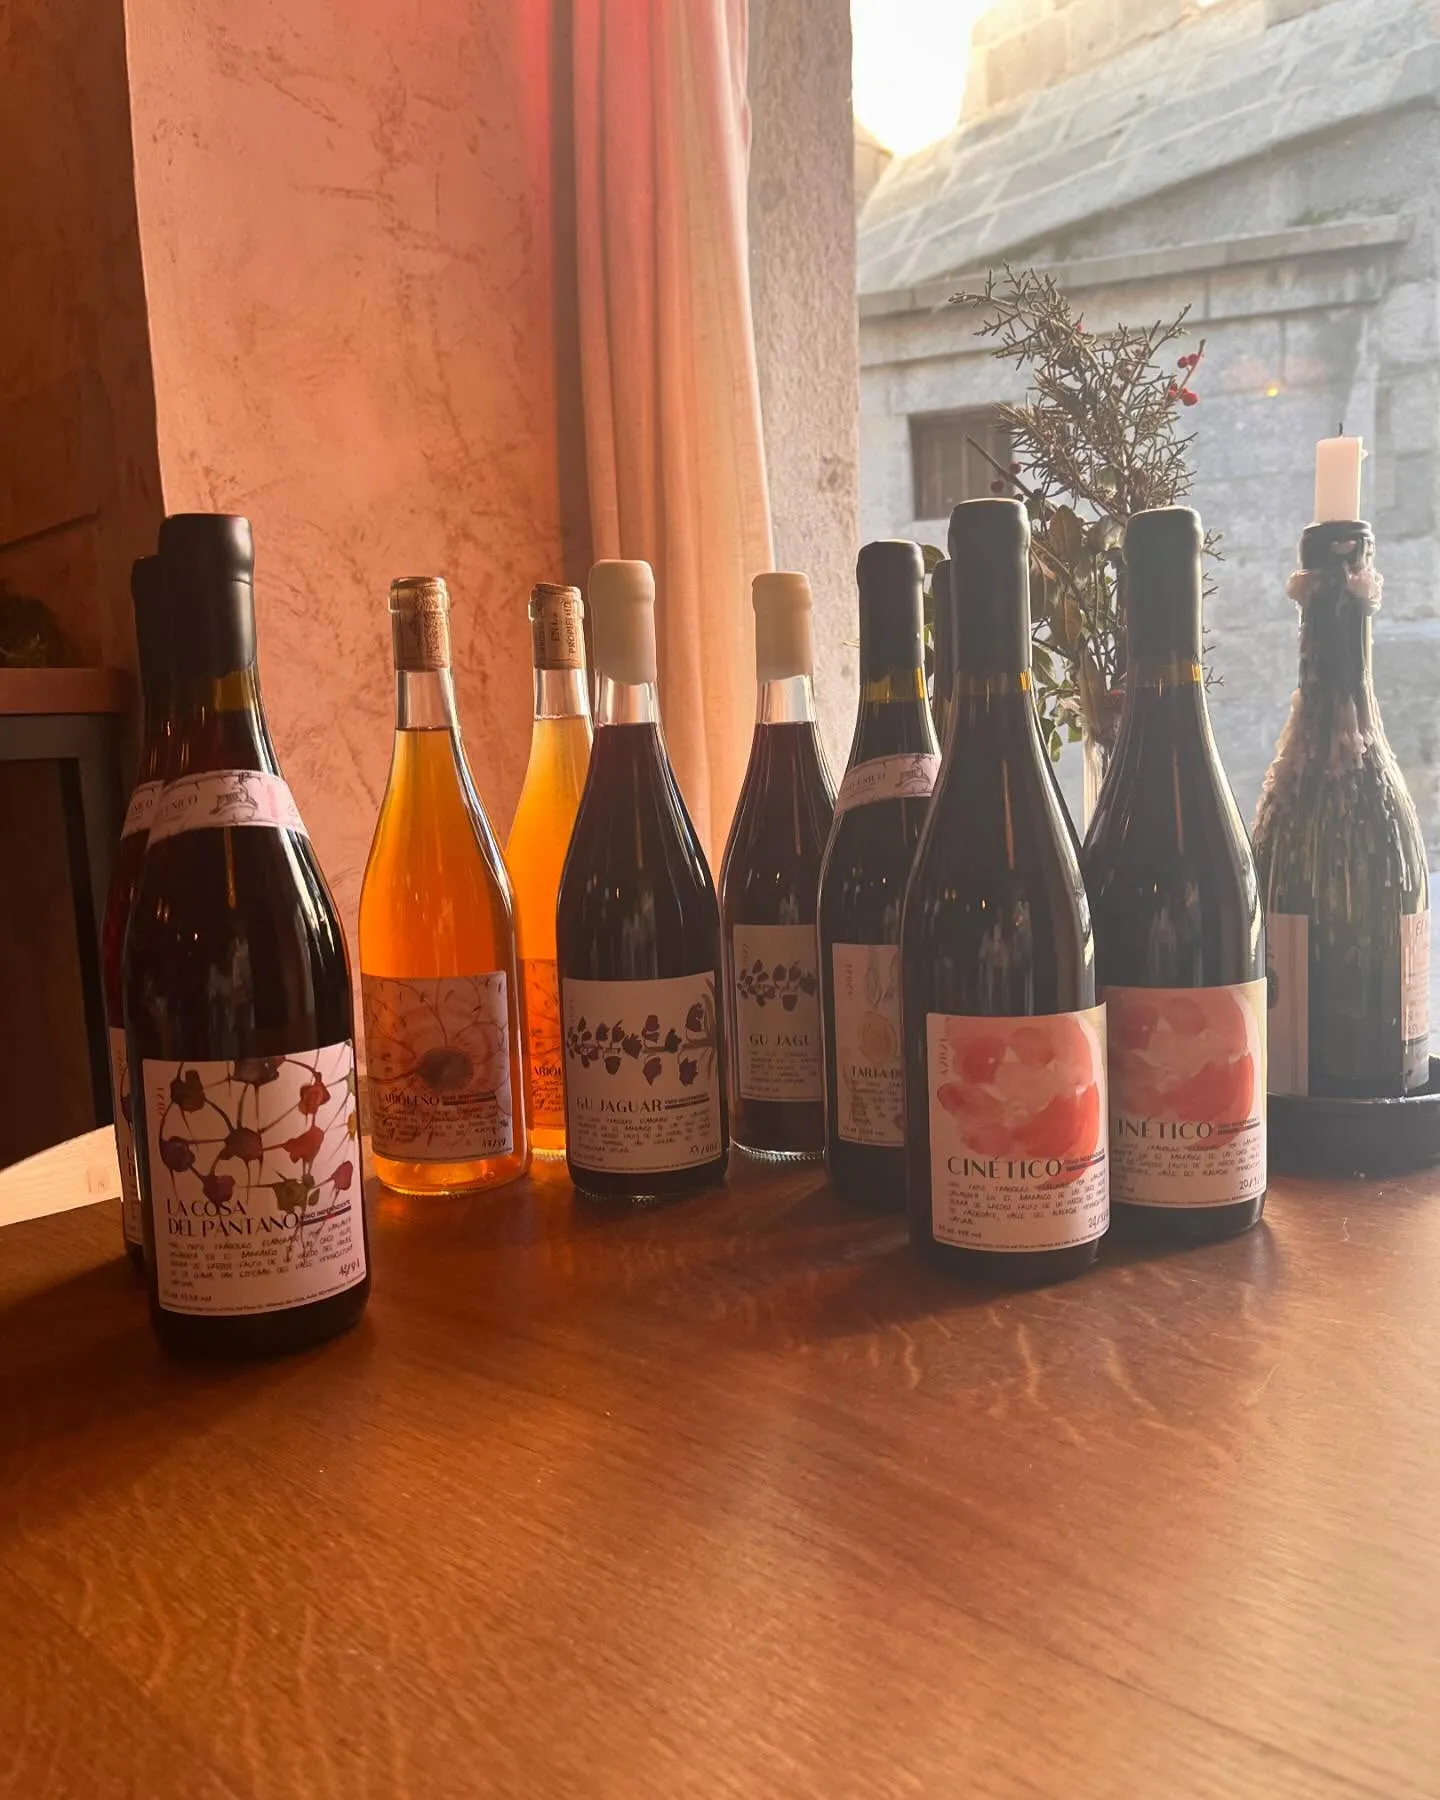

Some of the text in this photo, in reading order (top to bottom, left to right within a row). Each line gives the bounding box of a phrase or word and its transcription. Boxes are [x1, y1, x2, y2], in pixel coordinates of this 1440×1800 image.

[776, 1034, 808, 1047] JAGU
[576, 1096, 593, 1110] GU
[600, 1098, 663, 1113] JAGUAR
[1117, 1116, 1213, 1140] INÉTICO
[946, 1154, 1062, 1179] CINÉTICO
[166, 1197, 247, 1217] LA COSA
[167, 1212, 300, 1238] DEL PANTANO
